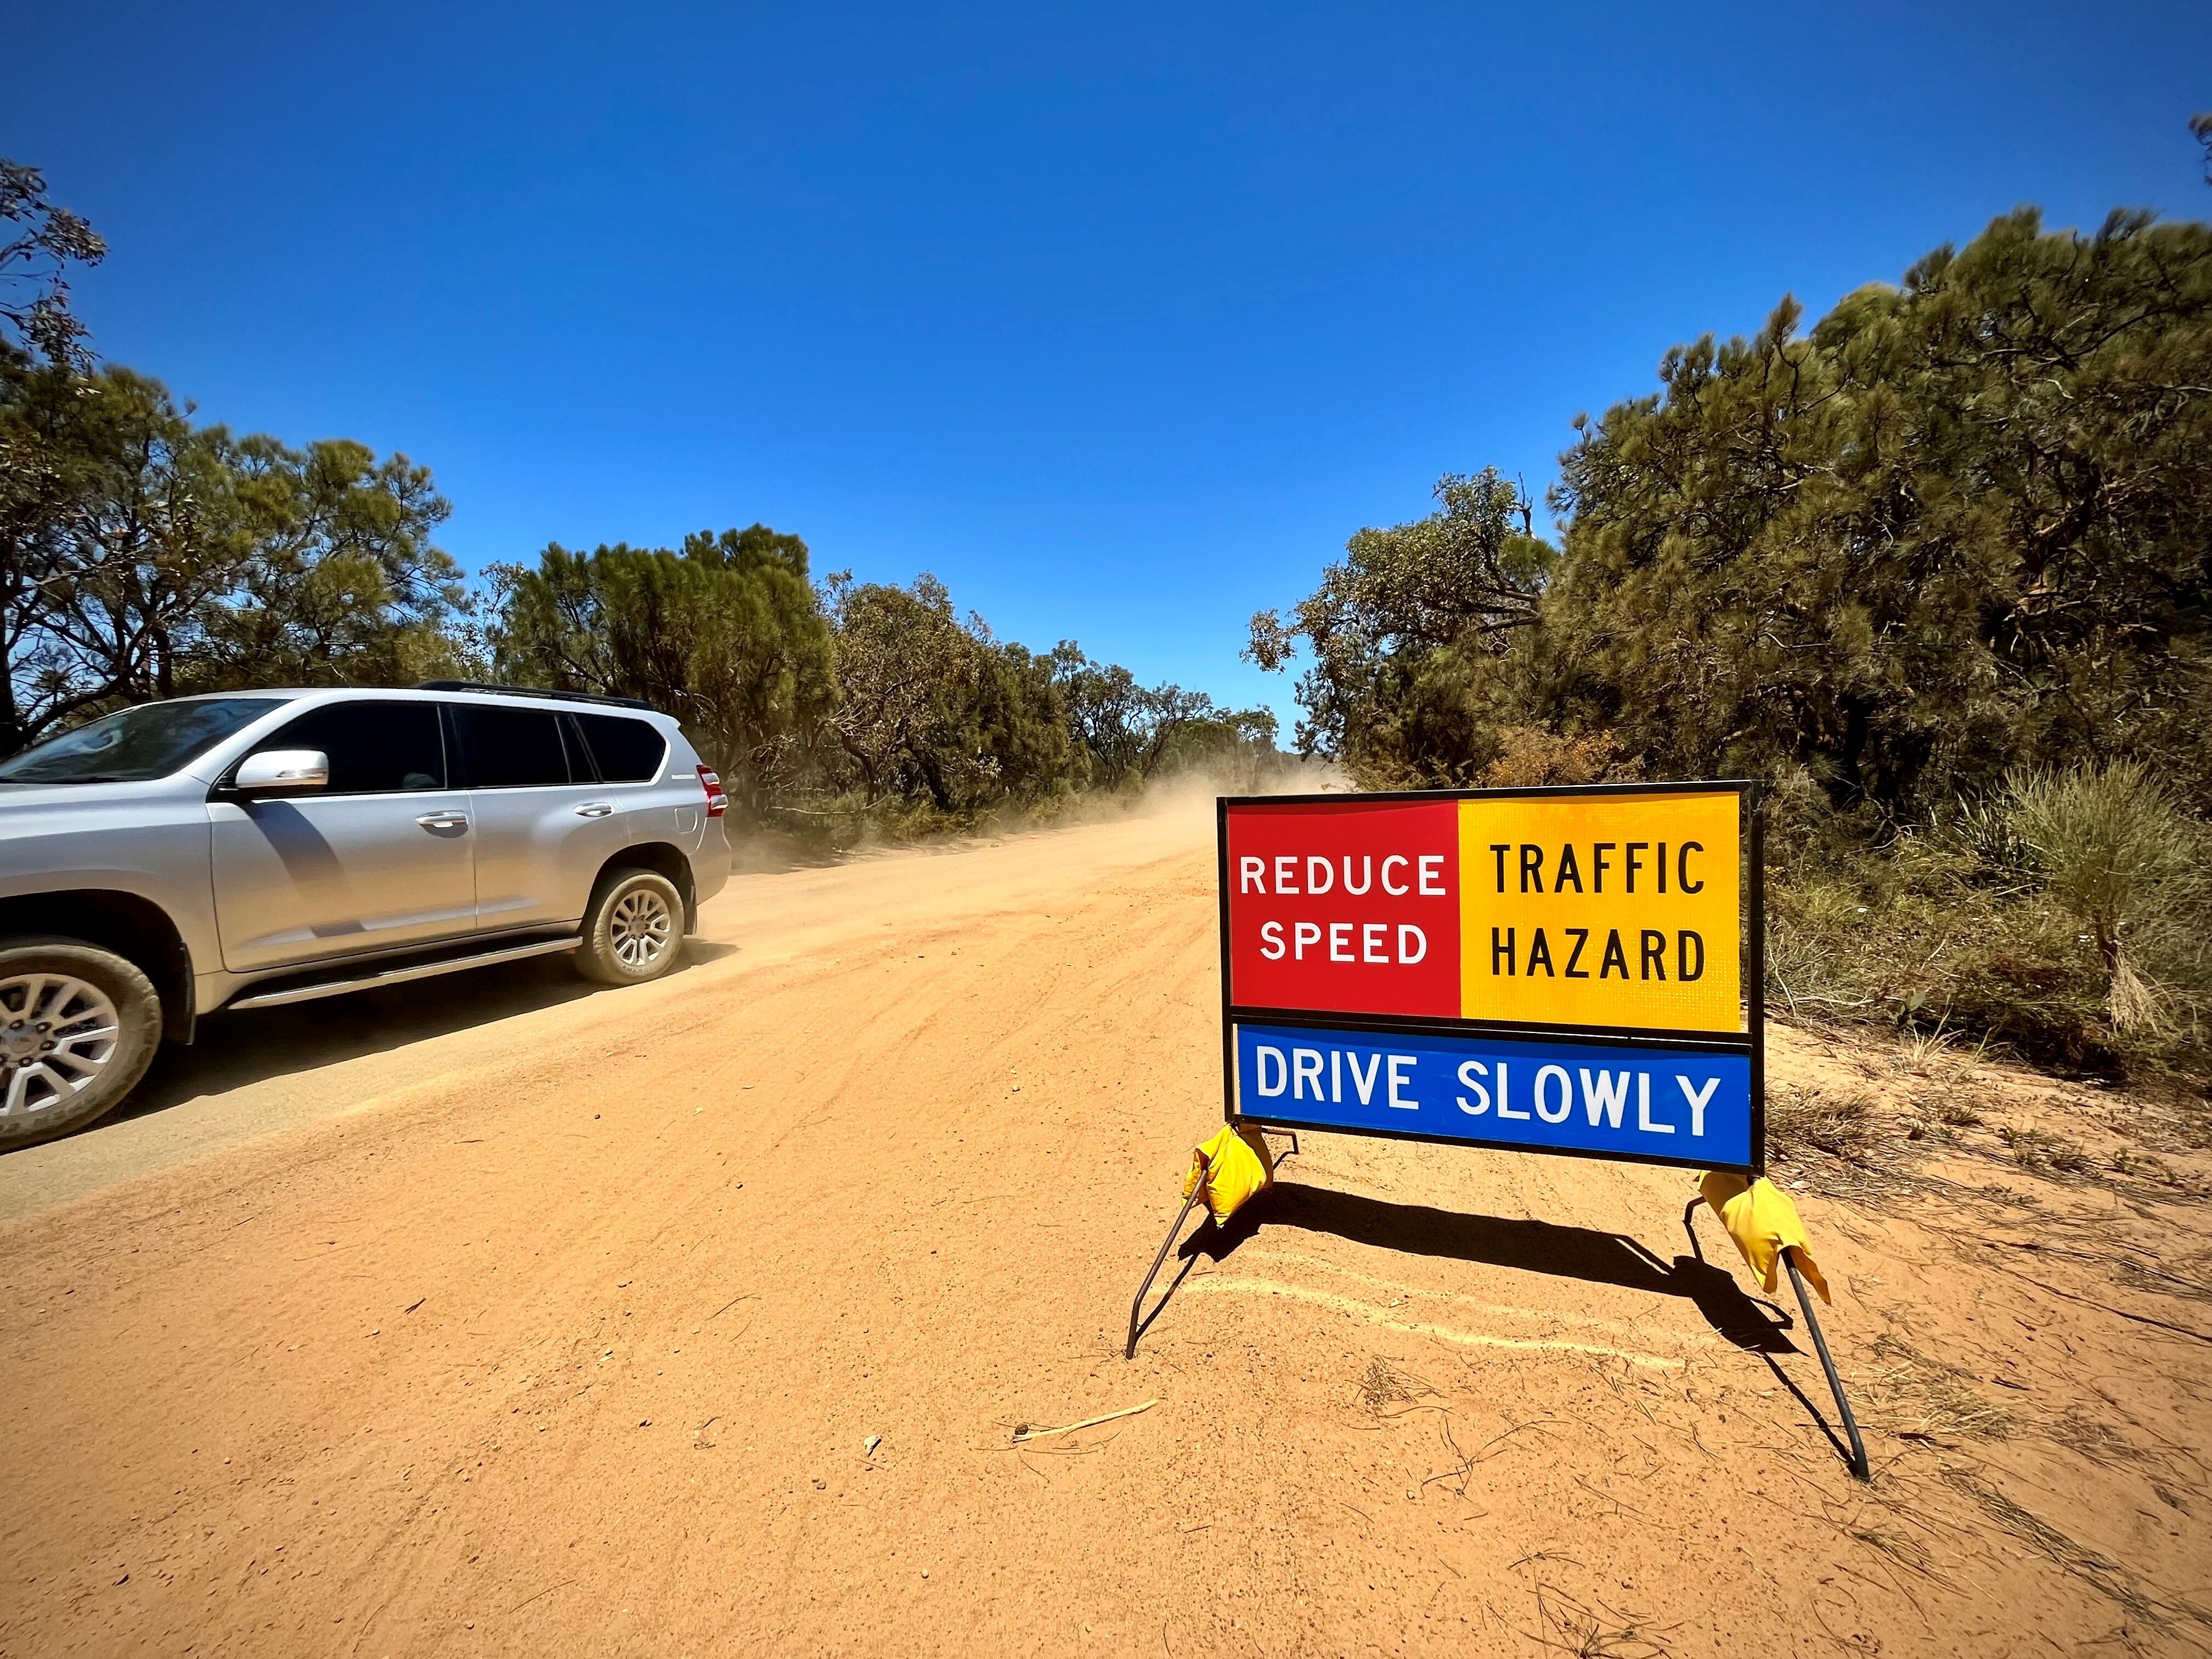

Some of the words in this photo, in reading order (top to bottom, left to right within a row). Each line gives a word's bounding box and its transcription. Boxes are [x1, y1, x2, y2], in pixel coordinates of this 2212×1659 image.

[1241, 855, 1446, 896] REDUCE
[1489, 841, 1704, 894] TRAFFIC
[1260, 921, 1427, 964] SPEED
[1492, 927, 1705, 981] HAZARD
[1257, 1046, 1419, 1110] DRIVE
[1456, 1060, 1721, 1136] SLOWLY
